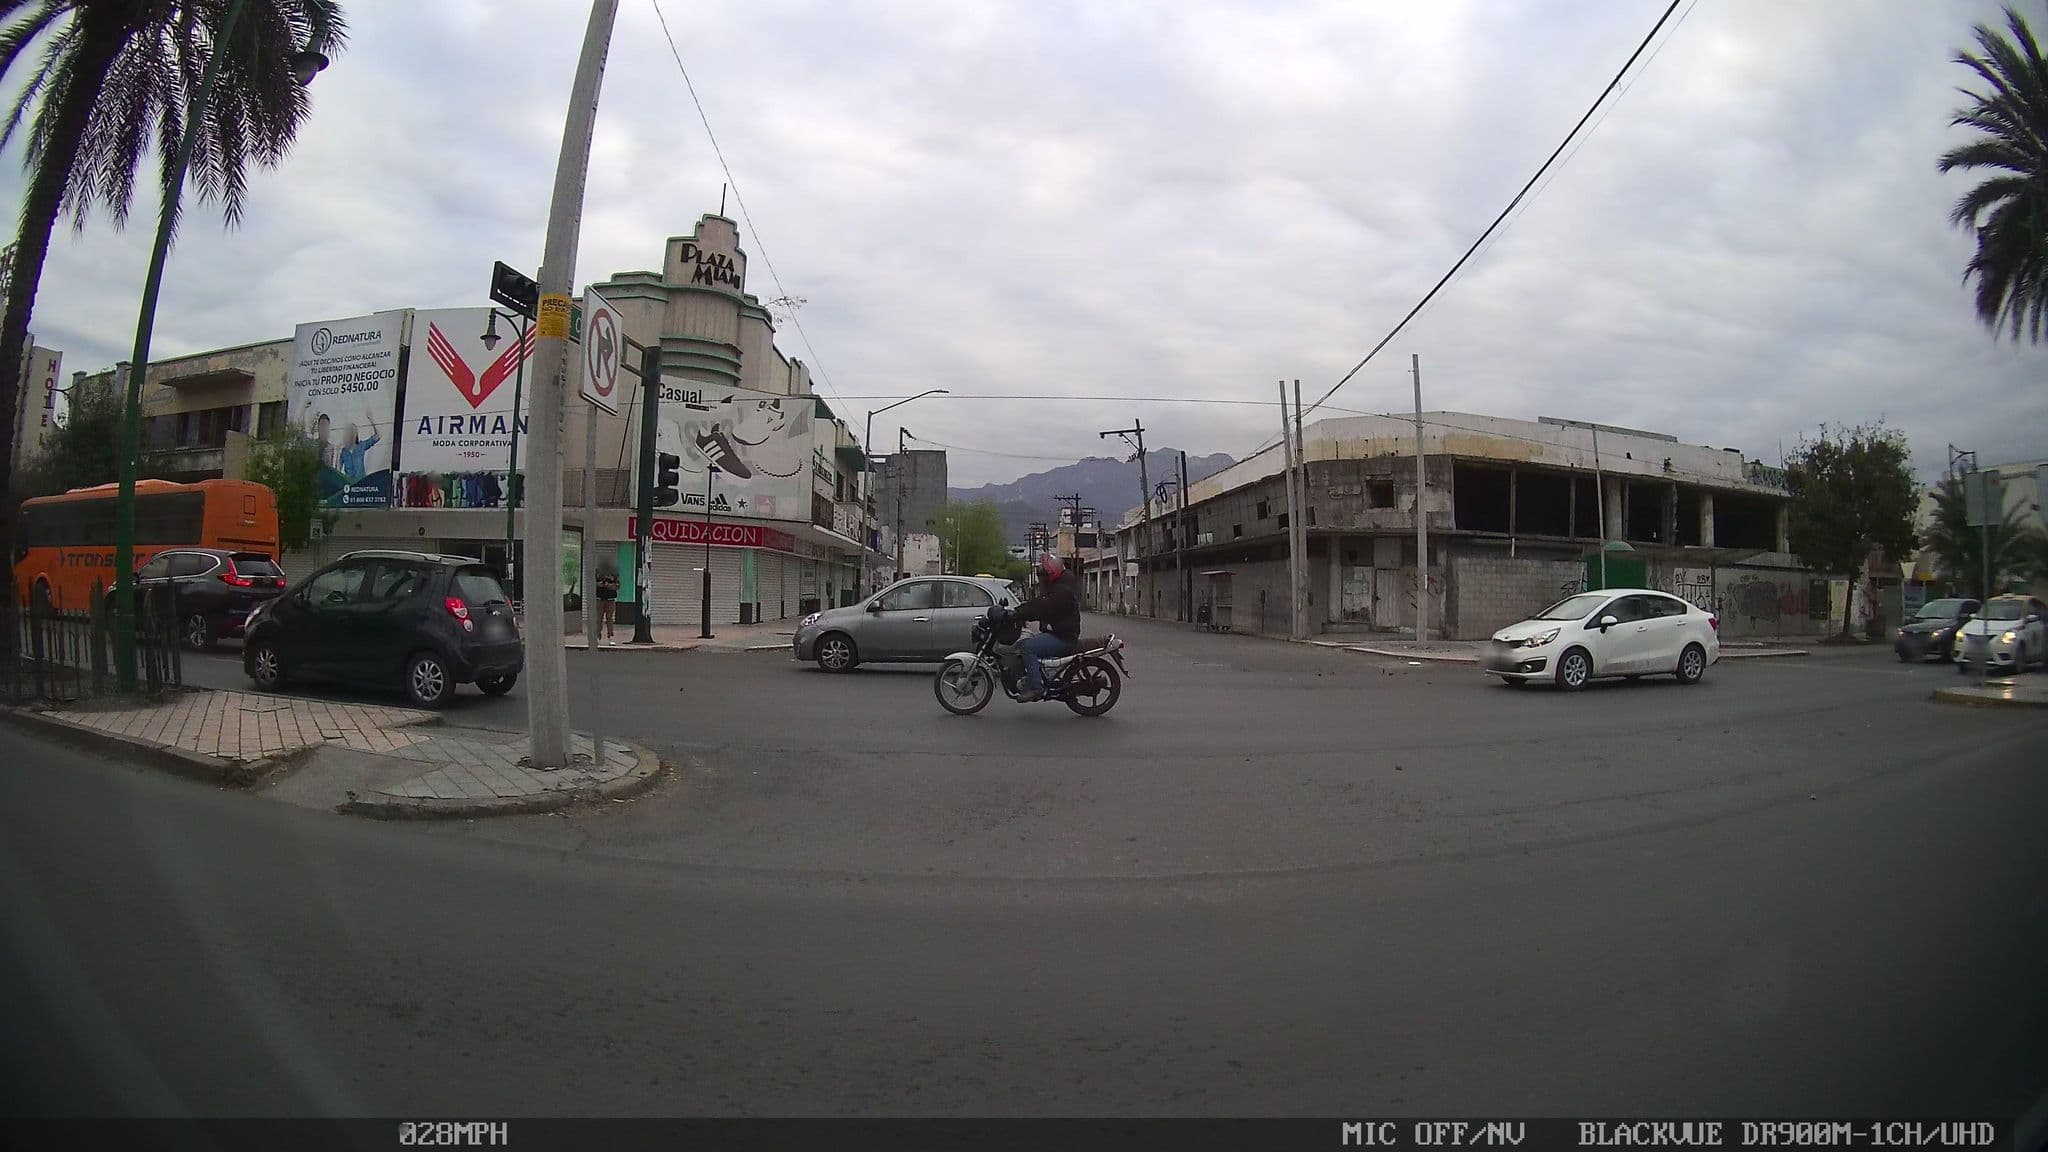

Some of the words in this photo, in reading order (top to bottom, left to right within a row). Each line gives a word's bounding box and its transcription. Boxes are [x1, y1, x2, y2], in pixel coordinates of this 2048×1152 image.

[680, 243, 734, 272] PLAZA
[691, 264, 741, 289] MIAMI
[332, 331, 381, 345] REDNATURA
[361, 351, 391, 360] ALCANZAR
[312, 378, 320, 386] TU
[321, 373, 353, 385] PROPIO
[354, 369, 395, 381] NEGOCIO
[308, 389, 321, 397] CON
[322, 387, 339, 396] SOLO
[340, 381, 379, 393] $450.00
[658, 383, 702, 404] Casual
[417, 415, 529, 435] AIRMAN
[681, 492, 705, 506] VANS
[633, 519, 756, 543] LQUIDACION
